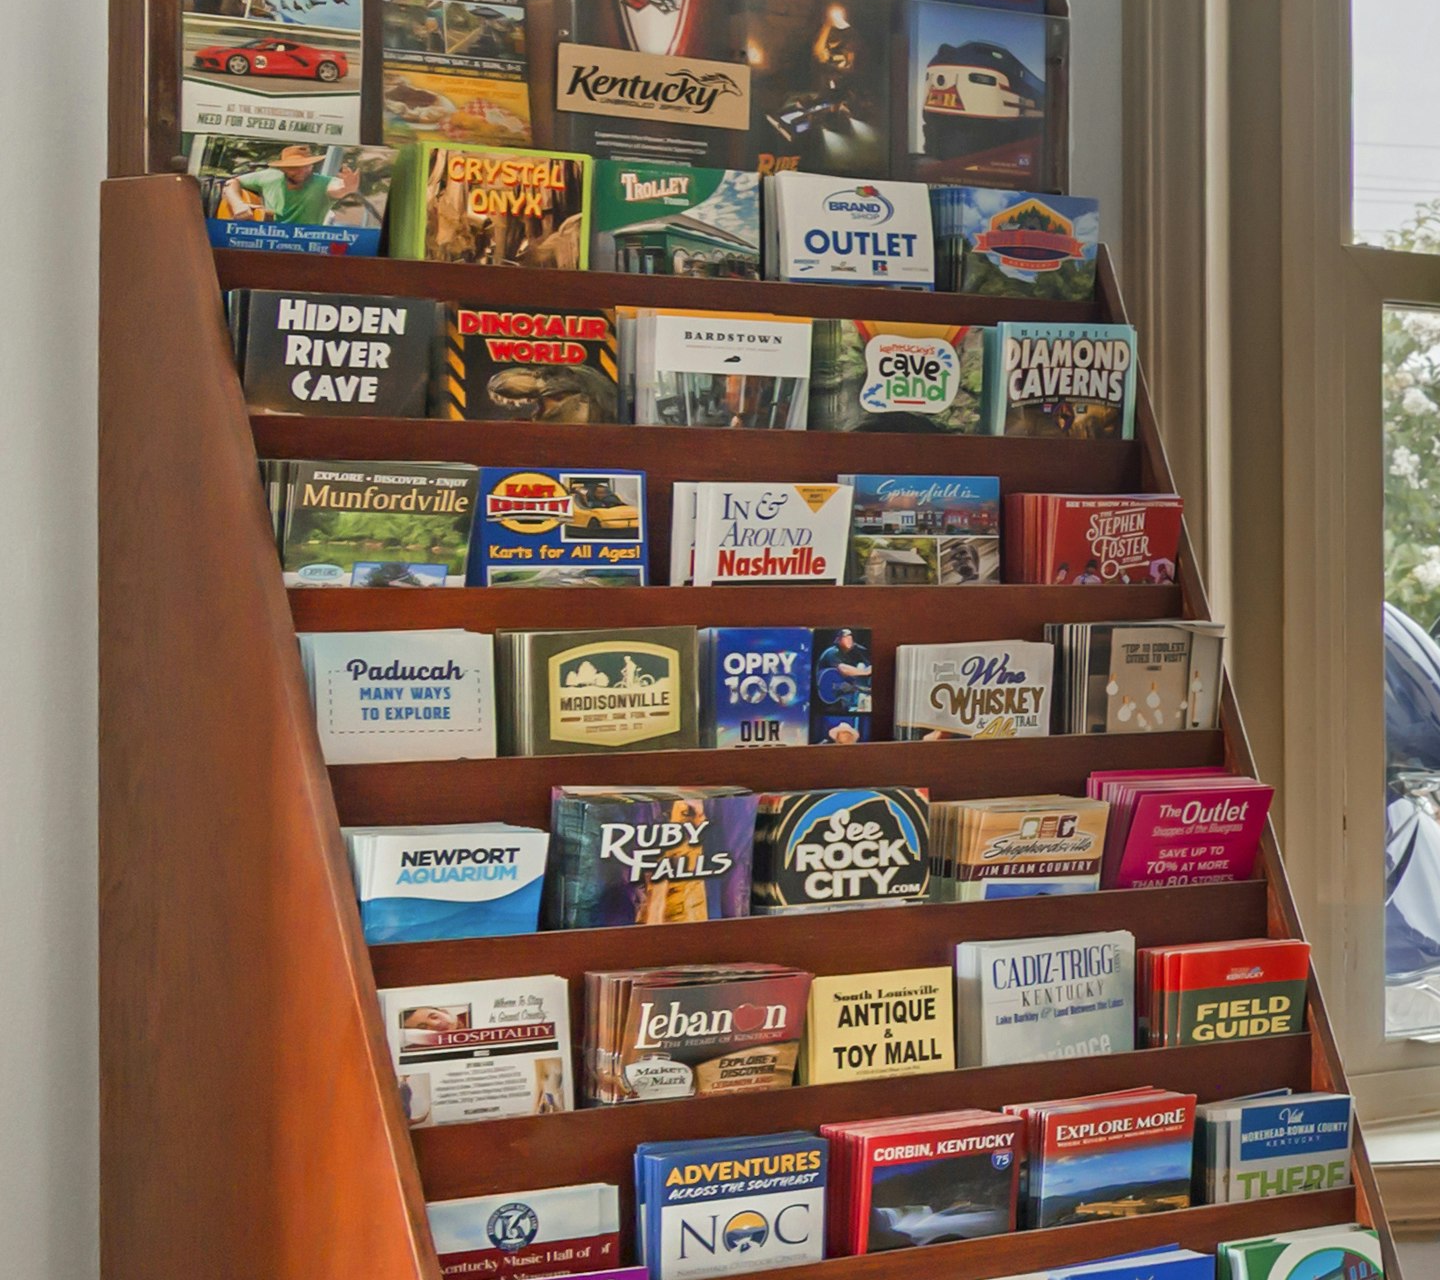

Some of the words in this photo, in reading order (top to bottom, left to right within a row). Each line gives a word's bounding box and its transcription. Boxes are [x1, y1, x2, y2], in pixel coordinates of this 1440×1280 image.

[448, 155, 565, 189] CRYSTAL
[469, 187, 544, 218] ONYX
[828, 200, 881, 215] BRAND
[226, 222, 285, 239] Franklin,
[292, 228, 360, 245] Kentucky
[804, 228, 918, 258] OUTLET
[277, 298, 406, 336] HIDDEN
[458, 309, 608, 341] DINOSAUR
[284, 335, 391, 369] RIVER
[486, 339, 587, 365] WORLD
[684, 330, 783, 345] BARDSTOWN
[1007, 338, 1130, 374] DIAMOND
[291, 369, 378, 403] CAVE
[1008, 367, 1123, 401] CAVERNS
[314, 471, 364, 483] EXPLORE
[374, 475, 426, 486] DISCOVER
[436, 478, 468, 487] ENJOY
[302, 483, 469, 514] Munfordville
[490, 545, 532, 560] Karts
[540, 545, 564, 559] for
[572, 546, 591, 559] All
[599, 546, 640, 563] Ages!
[717, 546, 826, 577] Nashville
[346, 659, 464, 683] Paducah
[359, 686, 403, 701] MANY
[410, 686, 451, 701] WAYS
[560, 691, 670, 712] MADISONVILLE
[361, 706, 381, 720] TO
[385, 705, 451, 720] EXPLORE
[1181, 799, 1249, 824] Outlet
[401, 847, 520, 867] NEWPORT
[600, 820, 709, 866] RUBY
[796, 838, 909, 874] ROCK
[1159, 848, 1187, 859] SAVE
[1191, 847, 1206, 856] UP
[1211, 846, 1224, 855] TO
[396, 865, 518, 886] AQUARIUM
[630, 848, 732, 882] FALLS
[978, 864, 998, 877] JIM
[1001, 862, 1036, 876] BEAM
[1039, 860, 1094, 874] COUNTRY
[992, 943, 1114, 991] CADIZ-TRIGG
[1021, 980, 1105, 1007] KENTUCKY
[1196, 995, 1291, 1021] FIELD
[838, 997, 936, 1028] ANTIQUE
[1192, 1015, 1290, 1042] GUIDE
[832, 1043, 879, 1070] TOY
[885, 1038, 943, 1065] MALL
[1056, 1117, 1132, 1142] EXPLORE
[1136, 1107, 1185, 1130] MORE
[873, 1142, 933, 1162] CORBIN,
[936, 1132, 1014, 1155] KENTUCKY
[665, 1150, 821, 1188] ADVENTURES
